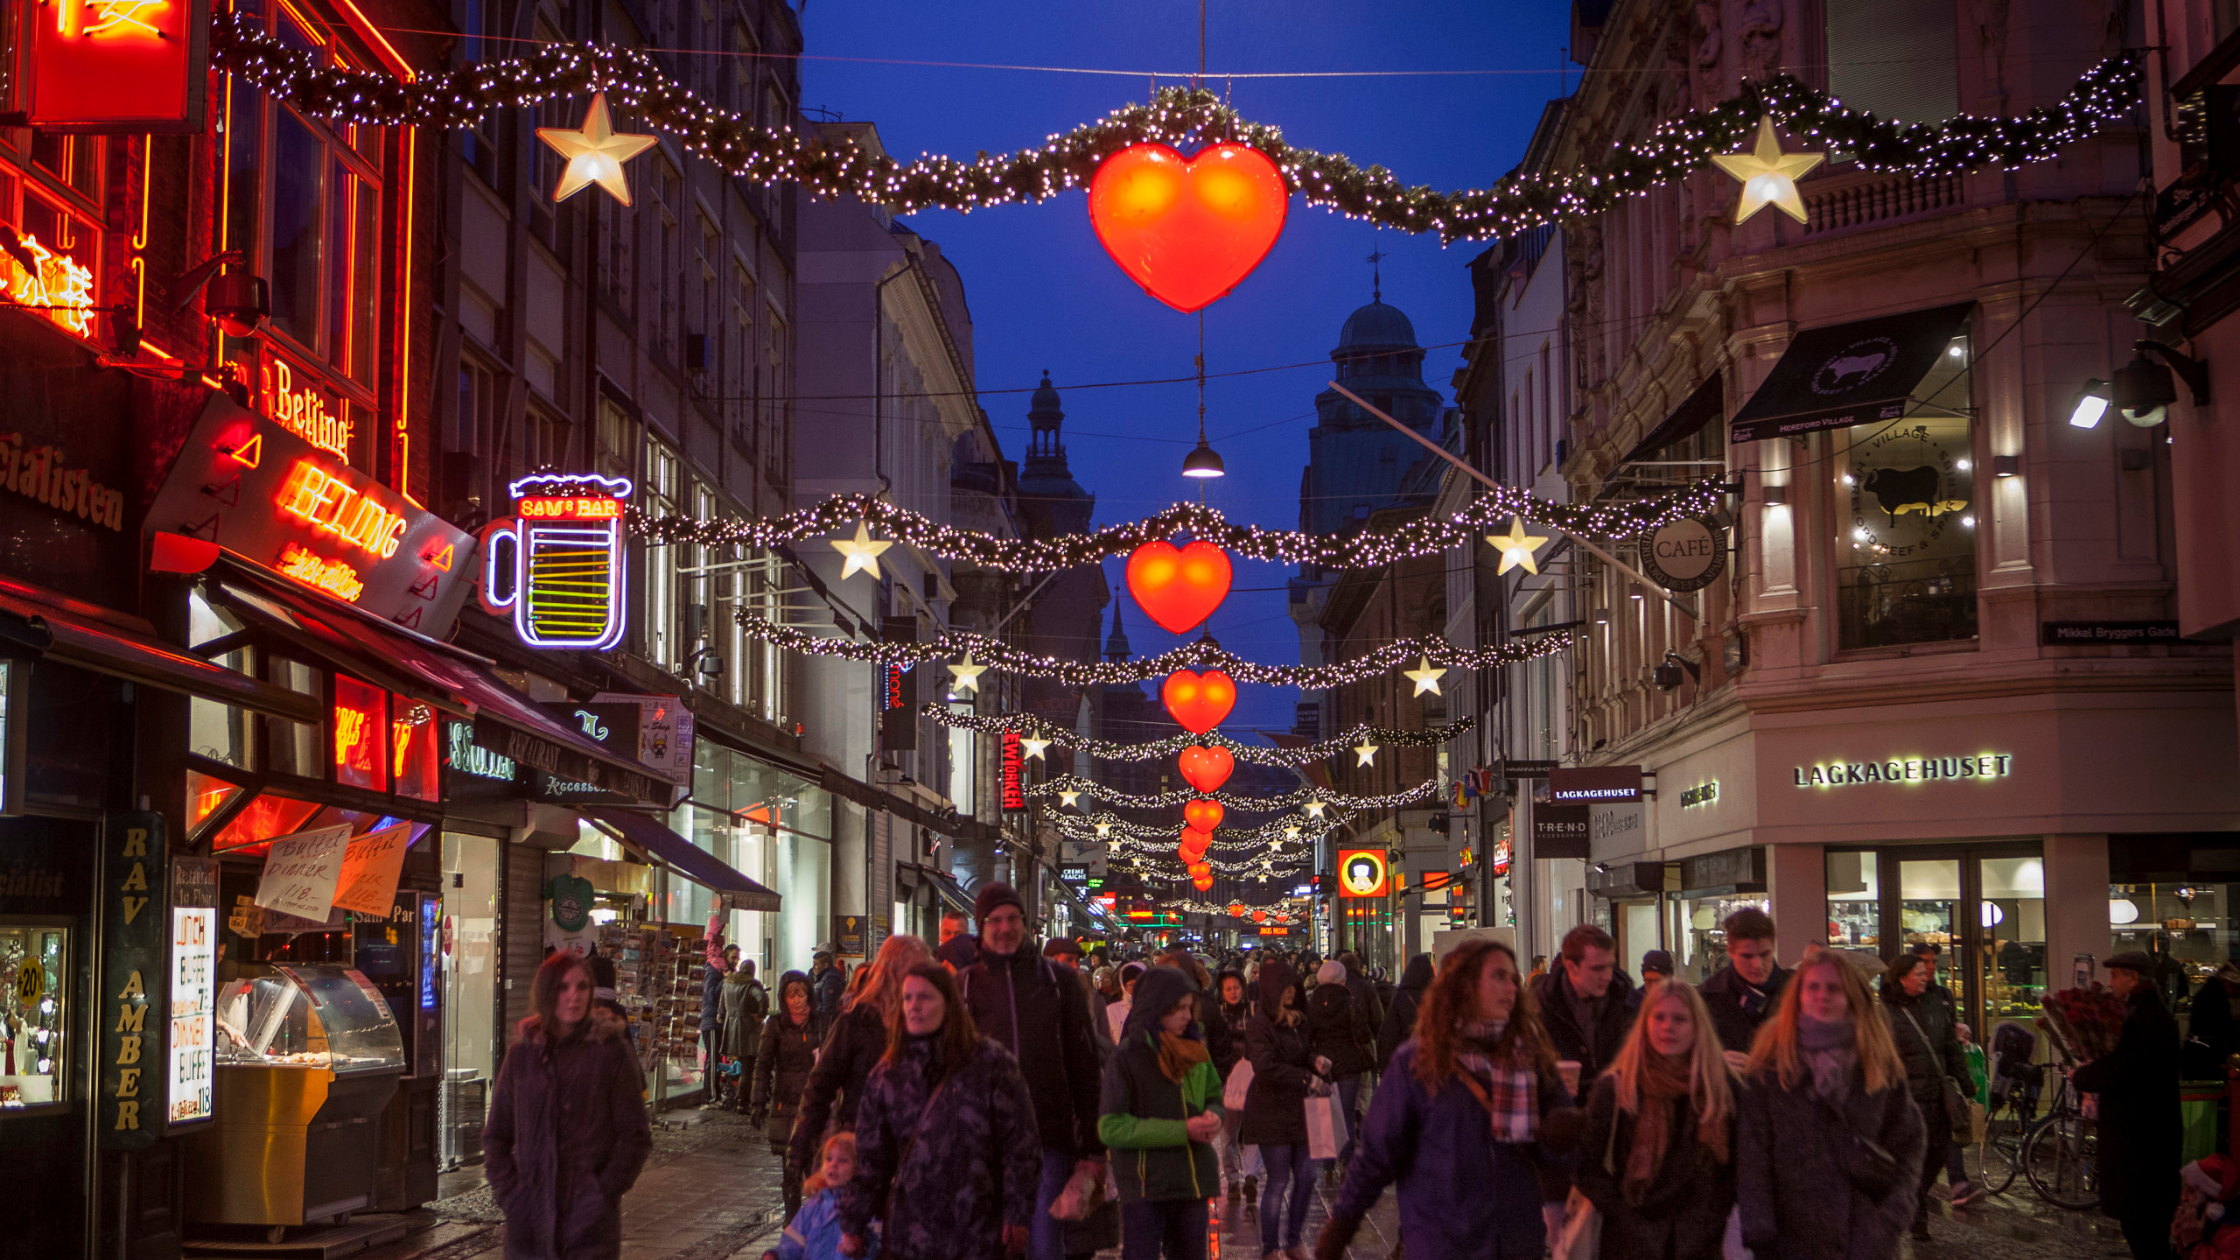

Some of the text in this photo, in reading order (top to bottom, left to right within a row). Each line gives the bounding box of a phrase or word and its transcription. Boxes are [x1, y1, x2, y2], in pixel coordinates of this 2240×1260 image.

[274, 359, 349, 465] Beijing
[1780, 415, 1855, 432] HEREFORD VILLAGE
[1872, 428, 1930, 448] VILLAGE
[285, 466, 407, 559] BEIJING
[576, 500, 619, 517] BAR
[1881, 543, 1915, 556] BEEF
[1931, 450, 1958, 540] SPARERIBS
[1641, 530, 1668, 584] HEREFORD
[1667, 578, 1695, 590] BEEF
[1705, 528, 1726, 580] SPARERIBS
[1656, 536, 1711, 558] CAFÉ
[2057, 626, 2177, 640] Mikkel Bryggers Gade
[651, 721, 671, 732] Shop
[1003, 727, 1027, 809] EWYORKER
[1793, 755, 2010, 787] LAGKAGEHUSET
[1555, 787, 1636, 799] LAGKAGEHUSET
[121, 827, 148, 925] RAV
[115, 970, 149, 1131] AMBER
[198, 1086, 212, 1115] 118
